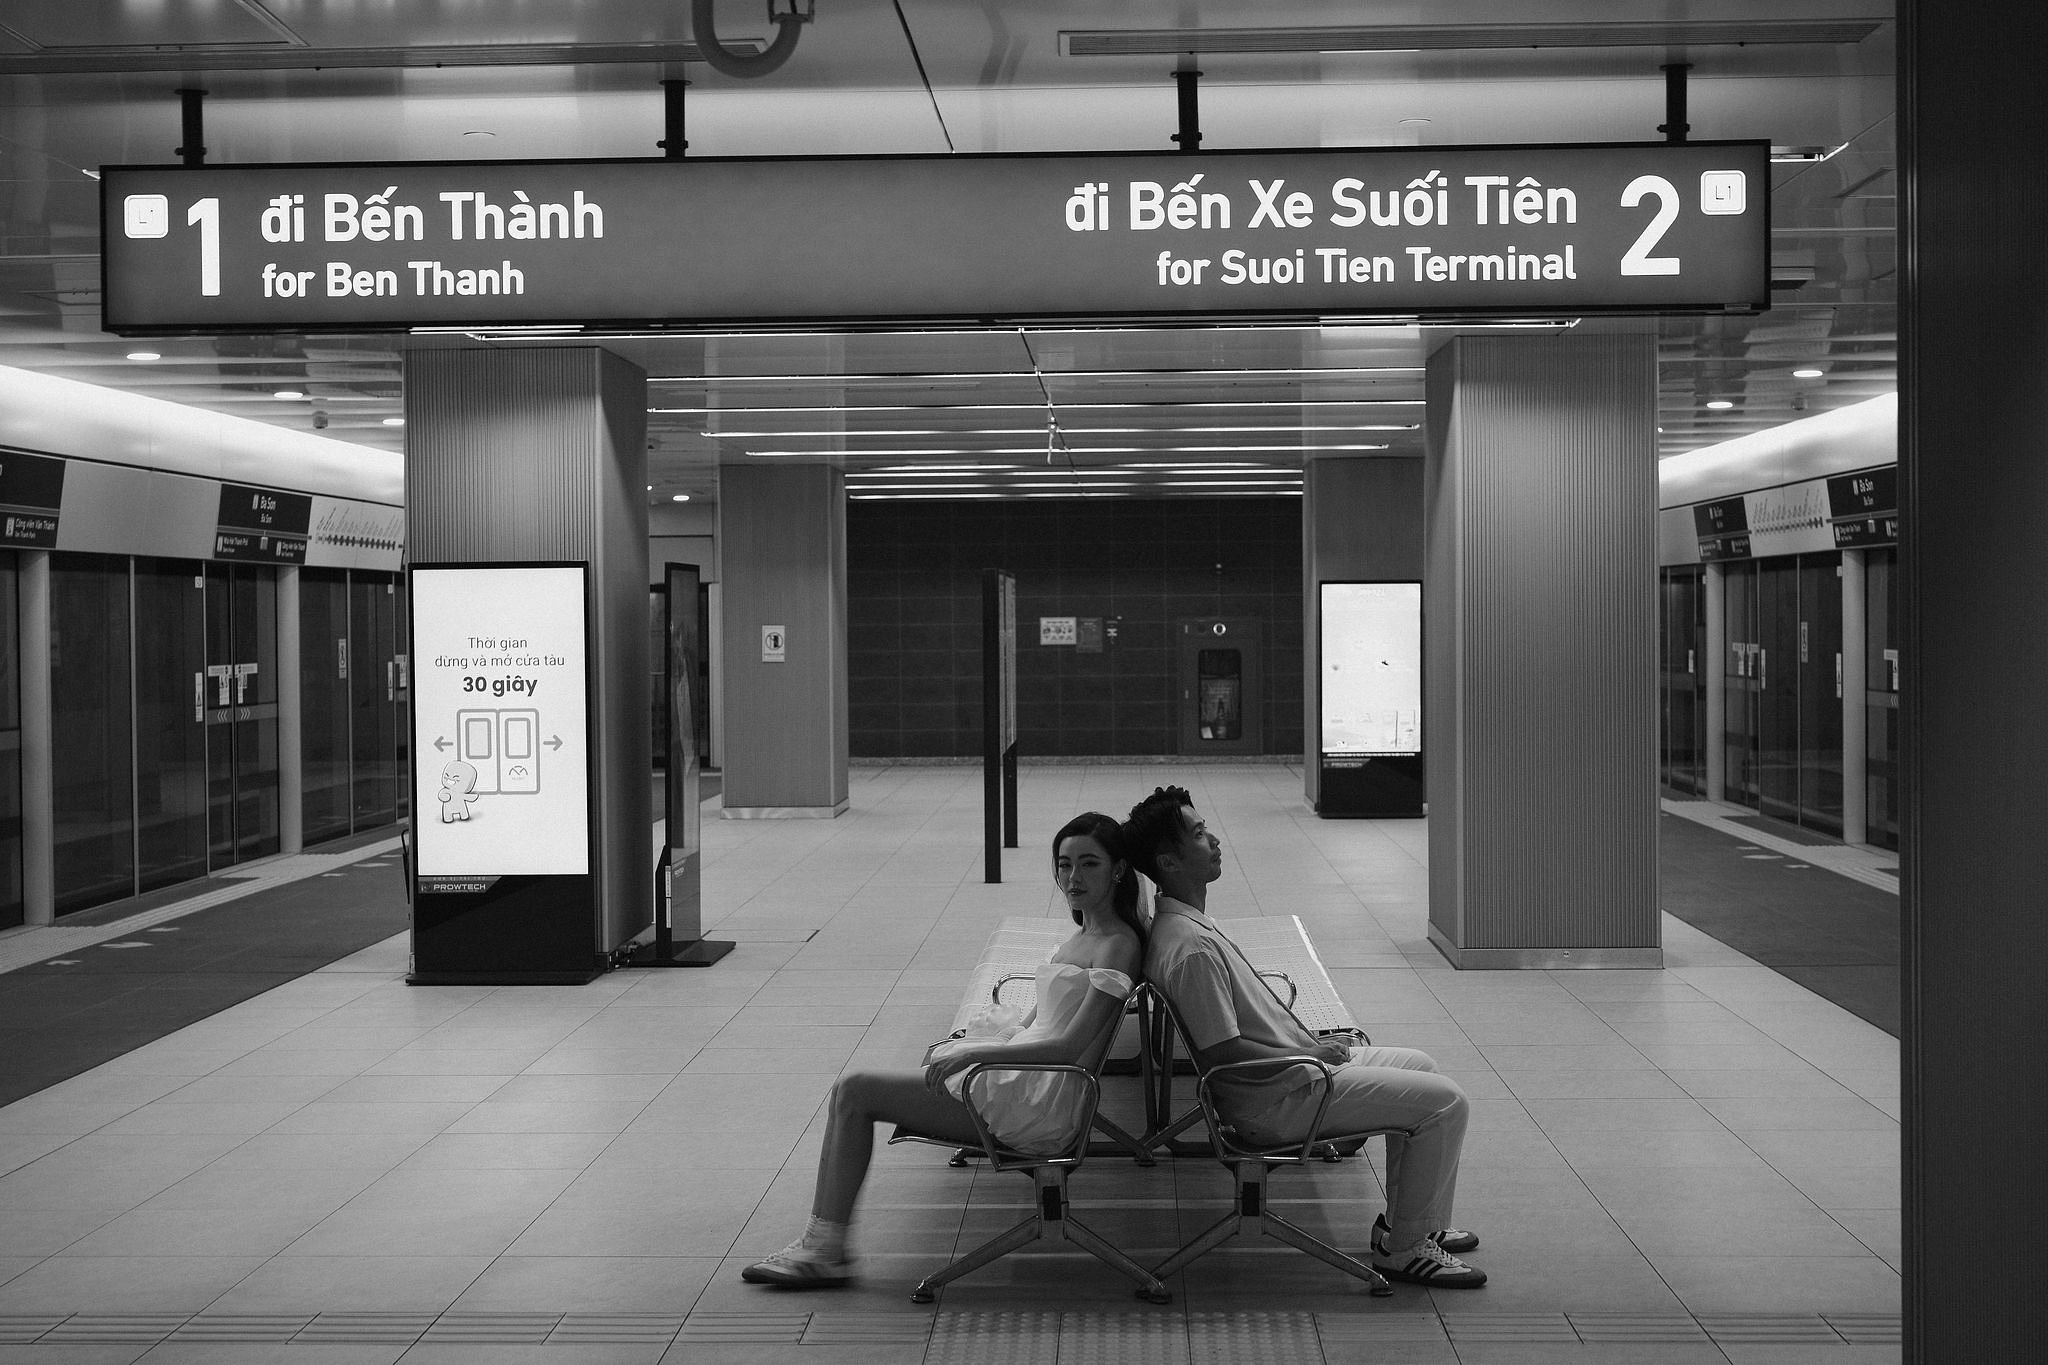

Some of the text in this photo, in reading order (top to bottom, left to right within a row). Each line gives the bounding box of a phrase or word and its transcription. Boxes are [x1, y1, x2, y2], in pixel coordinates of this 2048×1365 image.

[261, 186, 604, 242] đi Bến Thành
[1066, 169, 1577, 231] đi Bến Xe Suối Tiên
[1620, 175, 1681, 276] 2
[187, 197, 221, 297] 1
[1157, 245, 1577, 286] for Suoi Tien Terminal
[262, 261, 524, 298] for Ben Thanh
[434, 655, 468, 670] dừng
[472, 655, 487, 667] và
[544, 654, 565, 667] tàu
[467, 637, 528, 652] Thời gian
[463, 674, 538, 698] 30 giây
